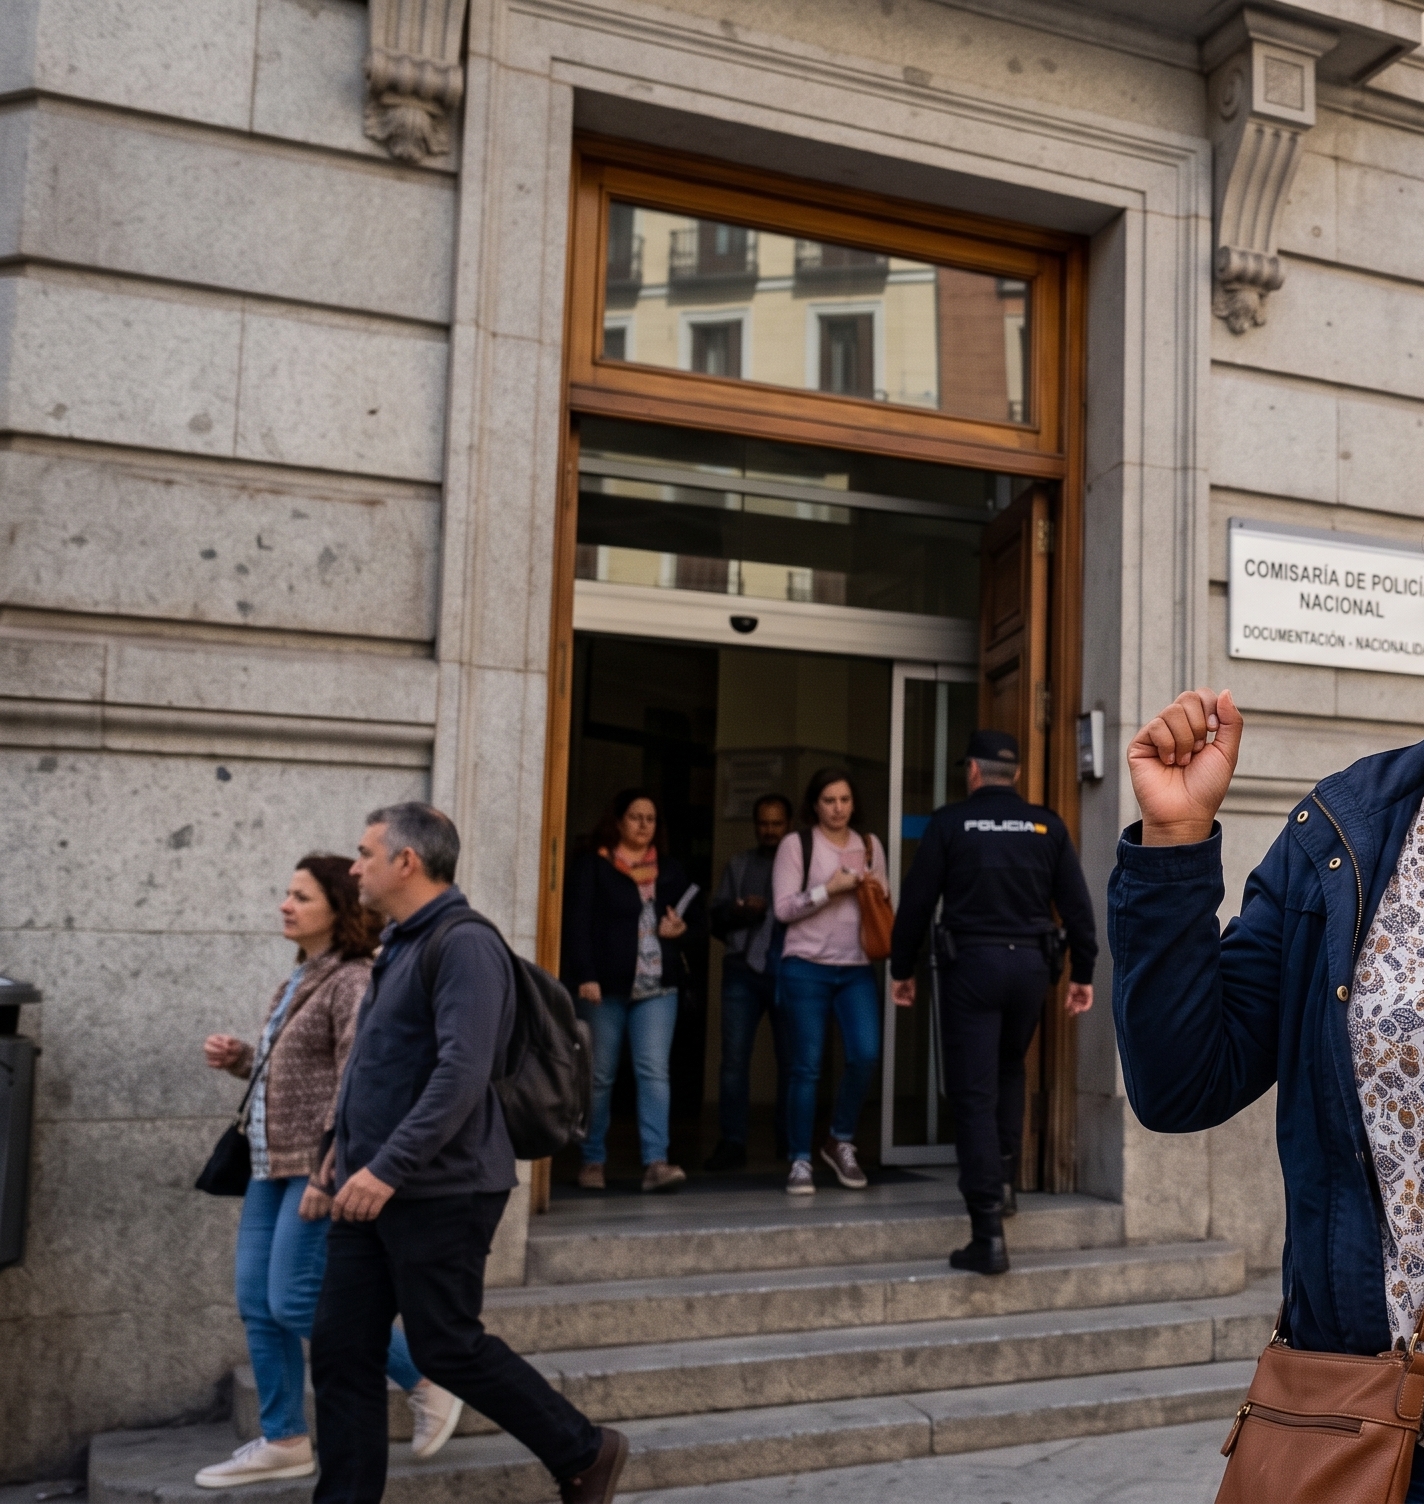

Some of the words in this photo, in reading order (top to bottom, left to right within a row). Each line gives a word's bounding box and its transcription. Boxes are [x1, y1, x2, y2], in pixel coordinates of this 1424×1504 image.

[1245, 559, 1339, 587] COMISARÍA
[1345, 571, 1366, 590] DE
[1300, 592, 1385, 618] NACIONAL
[1243, 625, 1345, 648] DOCUMENTACIÓN
